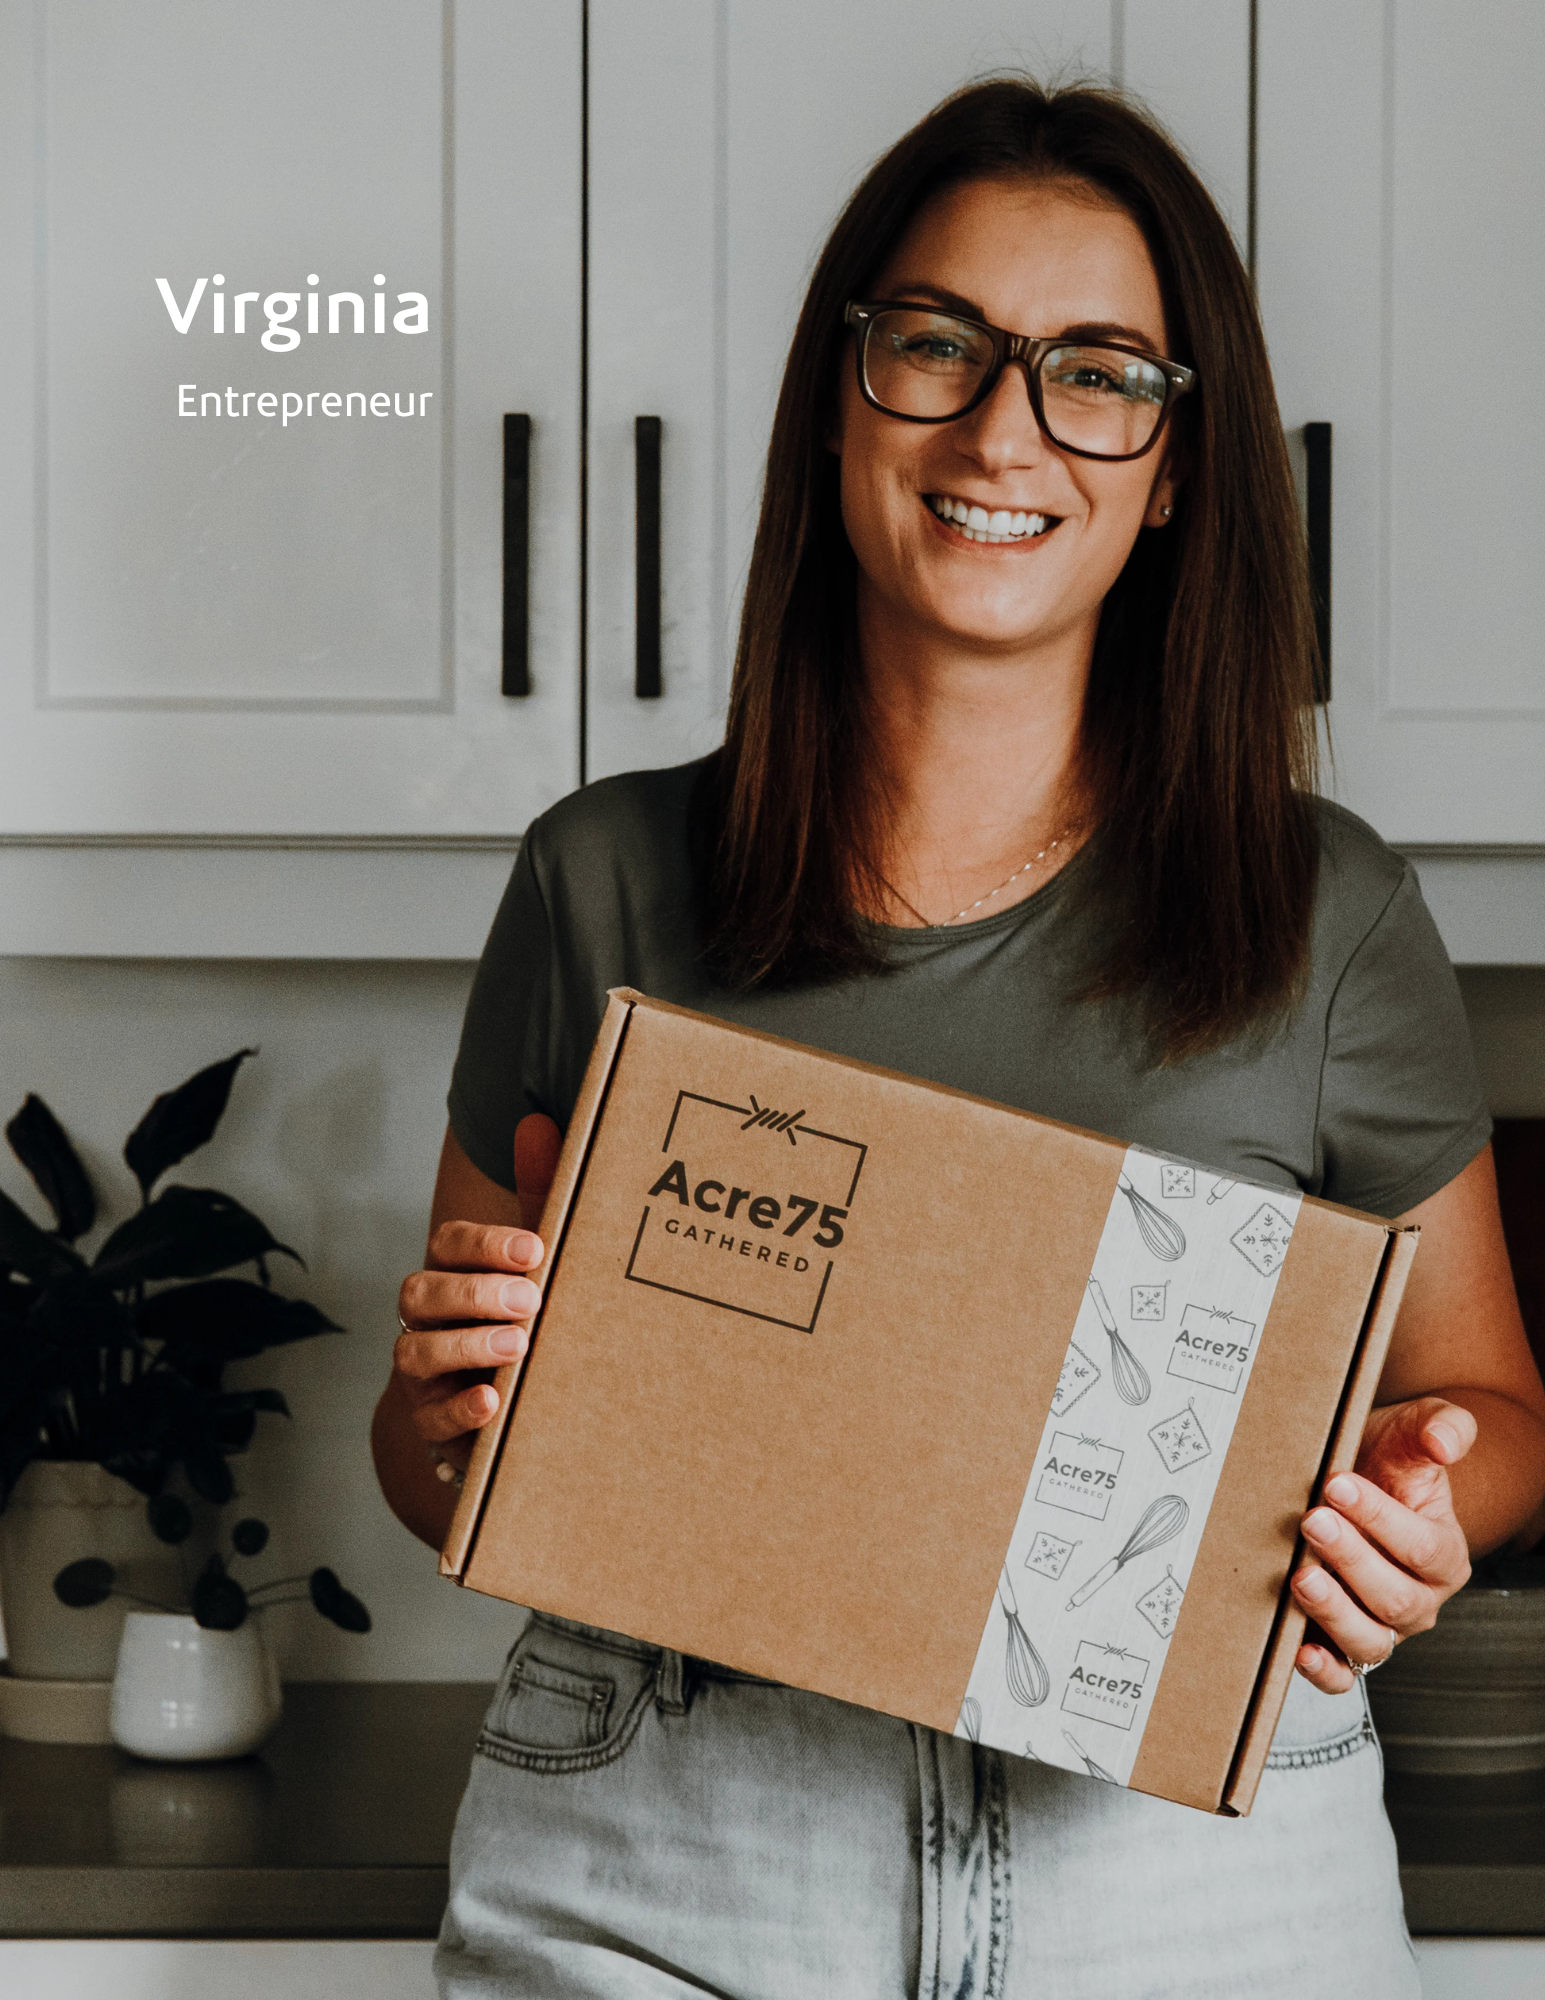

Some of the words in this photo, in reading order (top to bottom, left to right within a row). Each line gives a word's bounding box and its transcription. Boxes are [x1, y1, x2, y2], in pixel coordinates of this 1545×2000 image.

[648, 1160, 848, 1248] Acre75
[665, 1219, 809, 1273] GATHERED
[1175, 1329, 1249, 1362] Acre75
[1181, 1351, 1234, 1371] GATHERED
[1043, 1456, 1117, 1489] Acre75
[1049, 1478, 1103, 1499] GATHERED
[1069, 1665, 1143, 1699] Acre75
[1075, 1687, 1129, 1708] GATHERED
